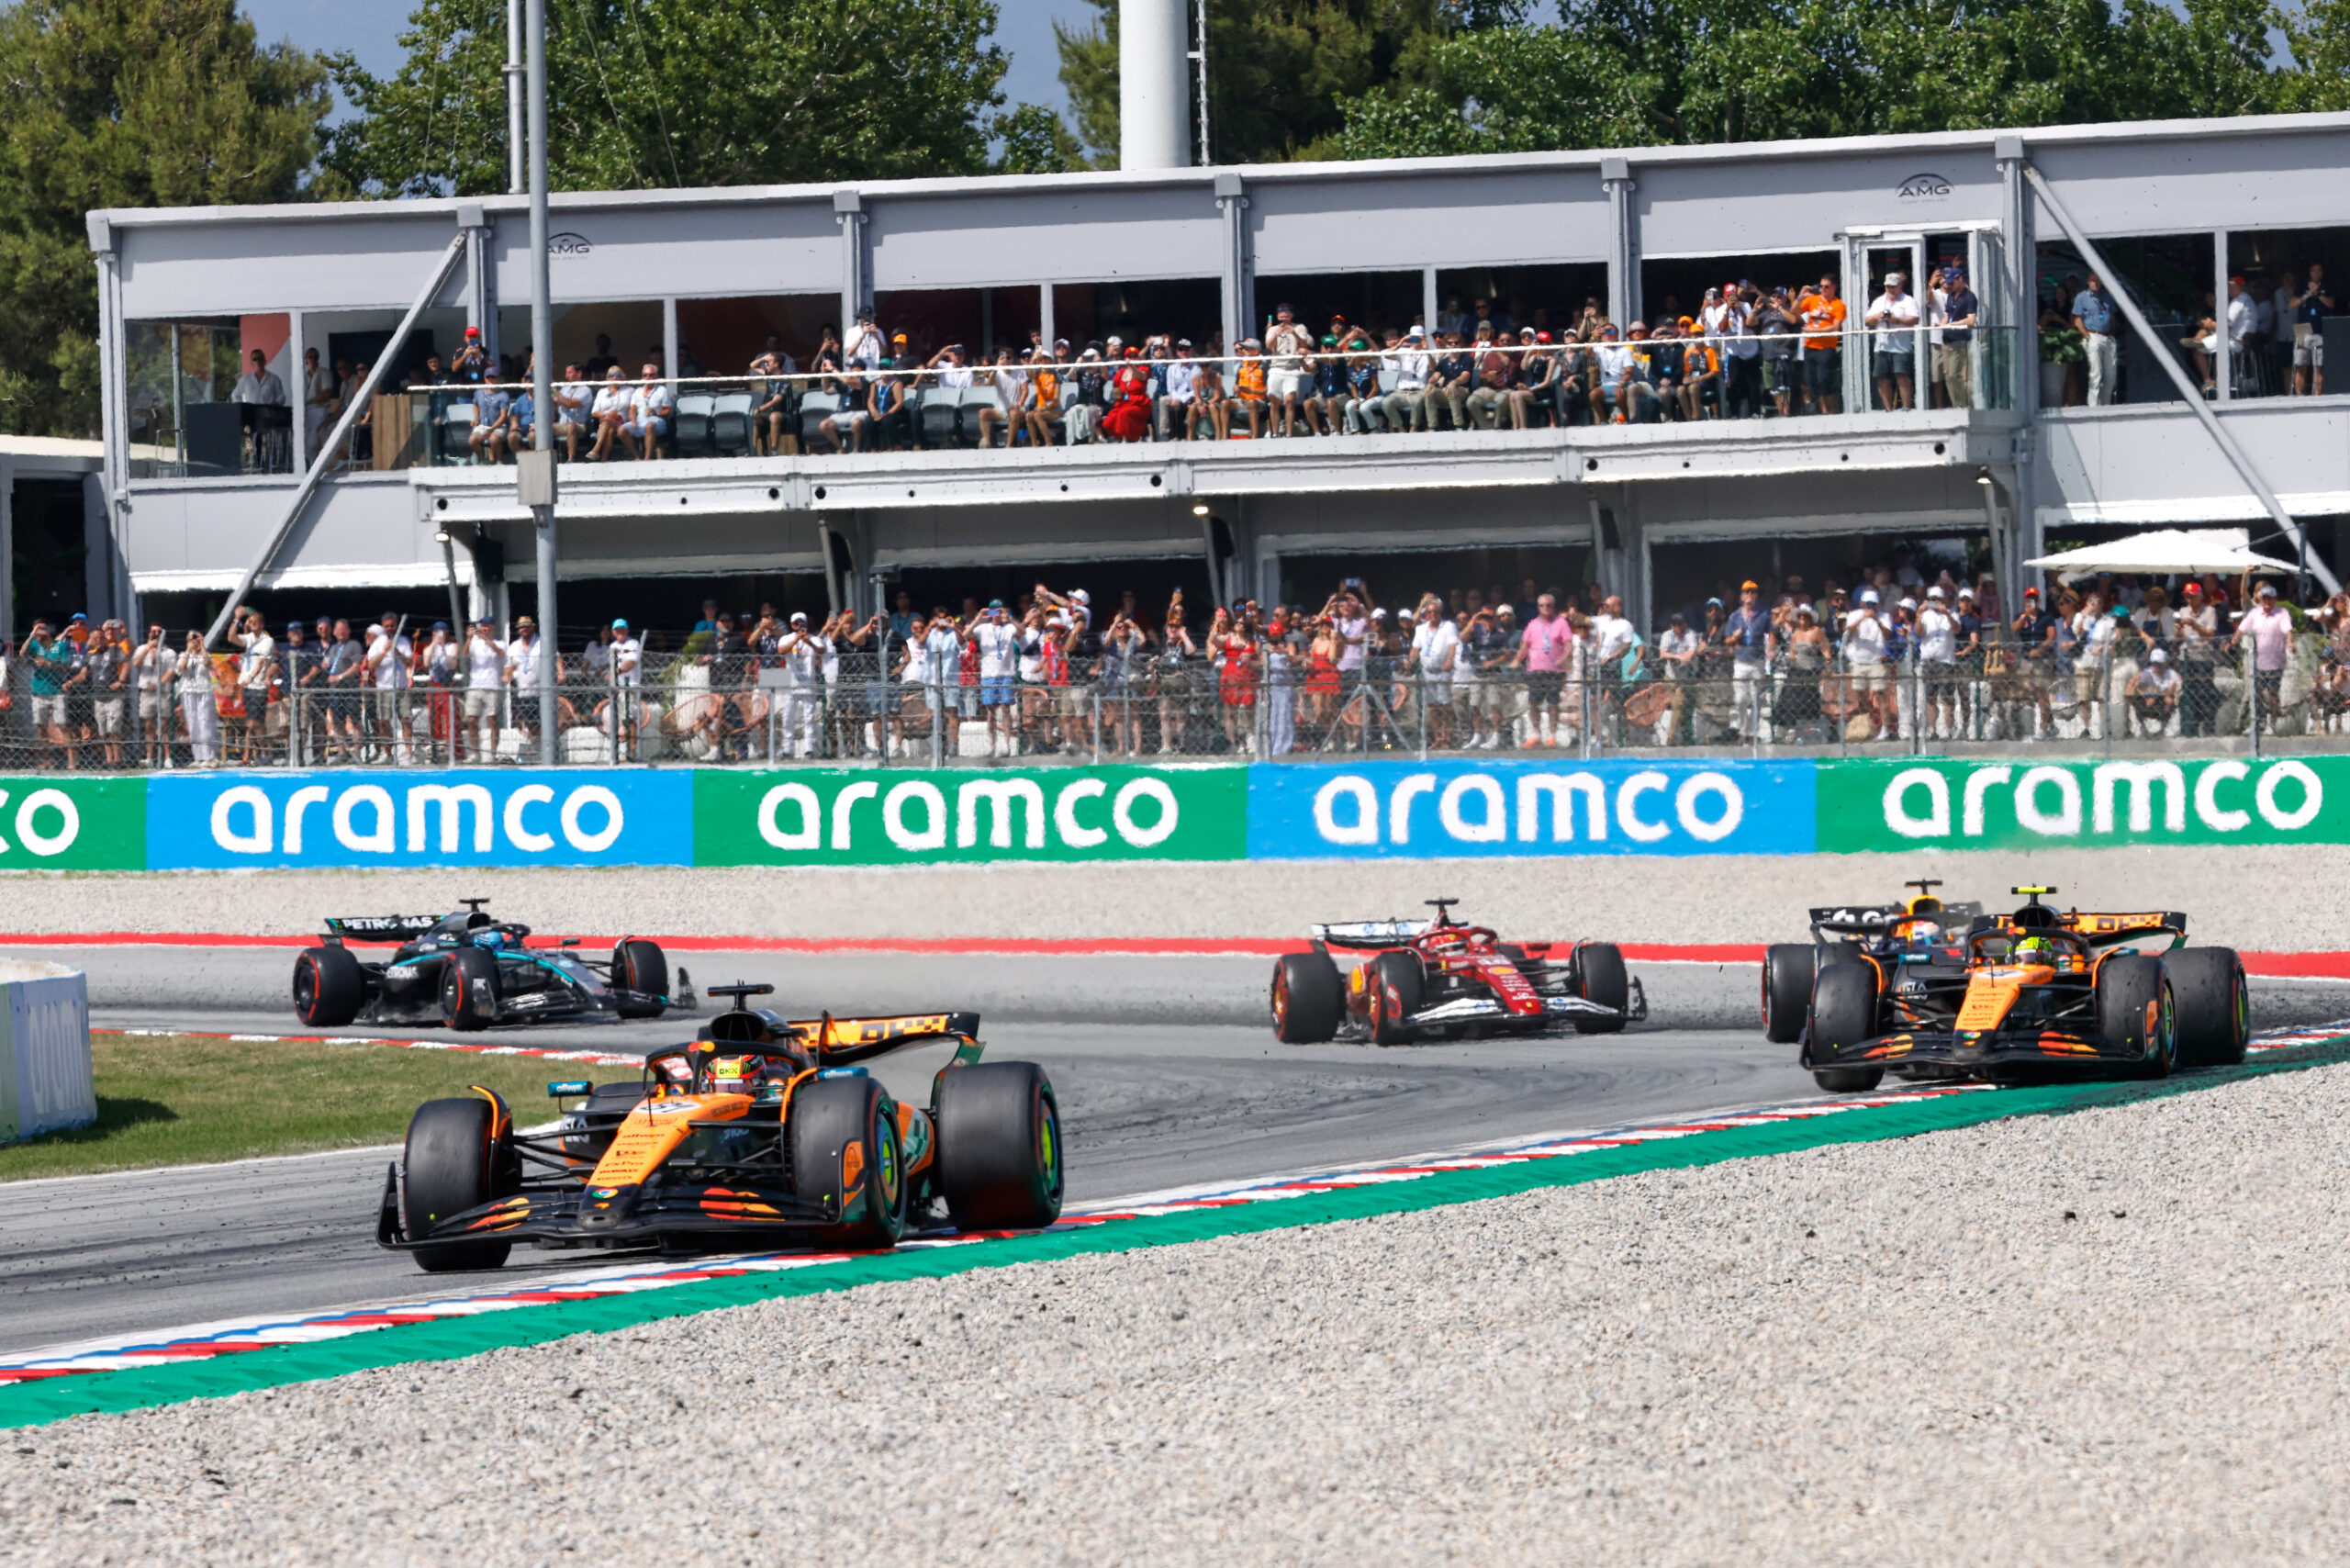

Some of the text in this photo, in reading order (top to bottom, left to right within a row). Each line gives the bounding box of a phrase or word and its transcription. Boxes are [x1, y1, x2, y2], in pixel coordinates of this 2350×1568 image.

[1898, 185, 1951, 197] AMG
[0, 789, 80, 857] o
[210, 783, 624, 855] aramco
[757, 777, 1179, 852] aramco
[1313, 770, 1744, 845] aramco
[1882, 759, 2323, 838] aramco
